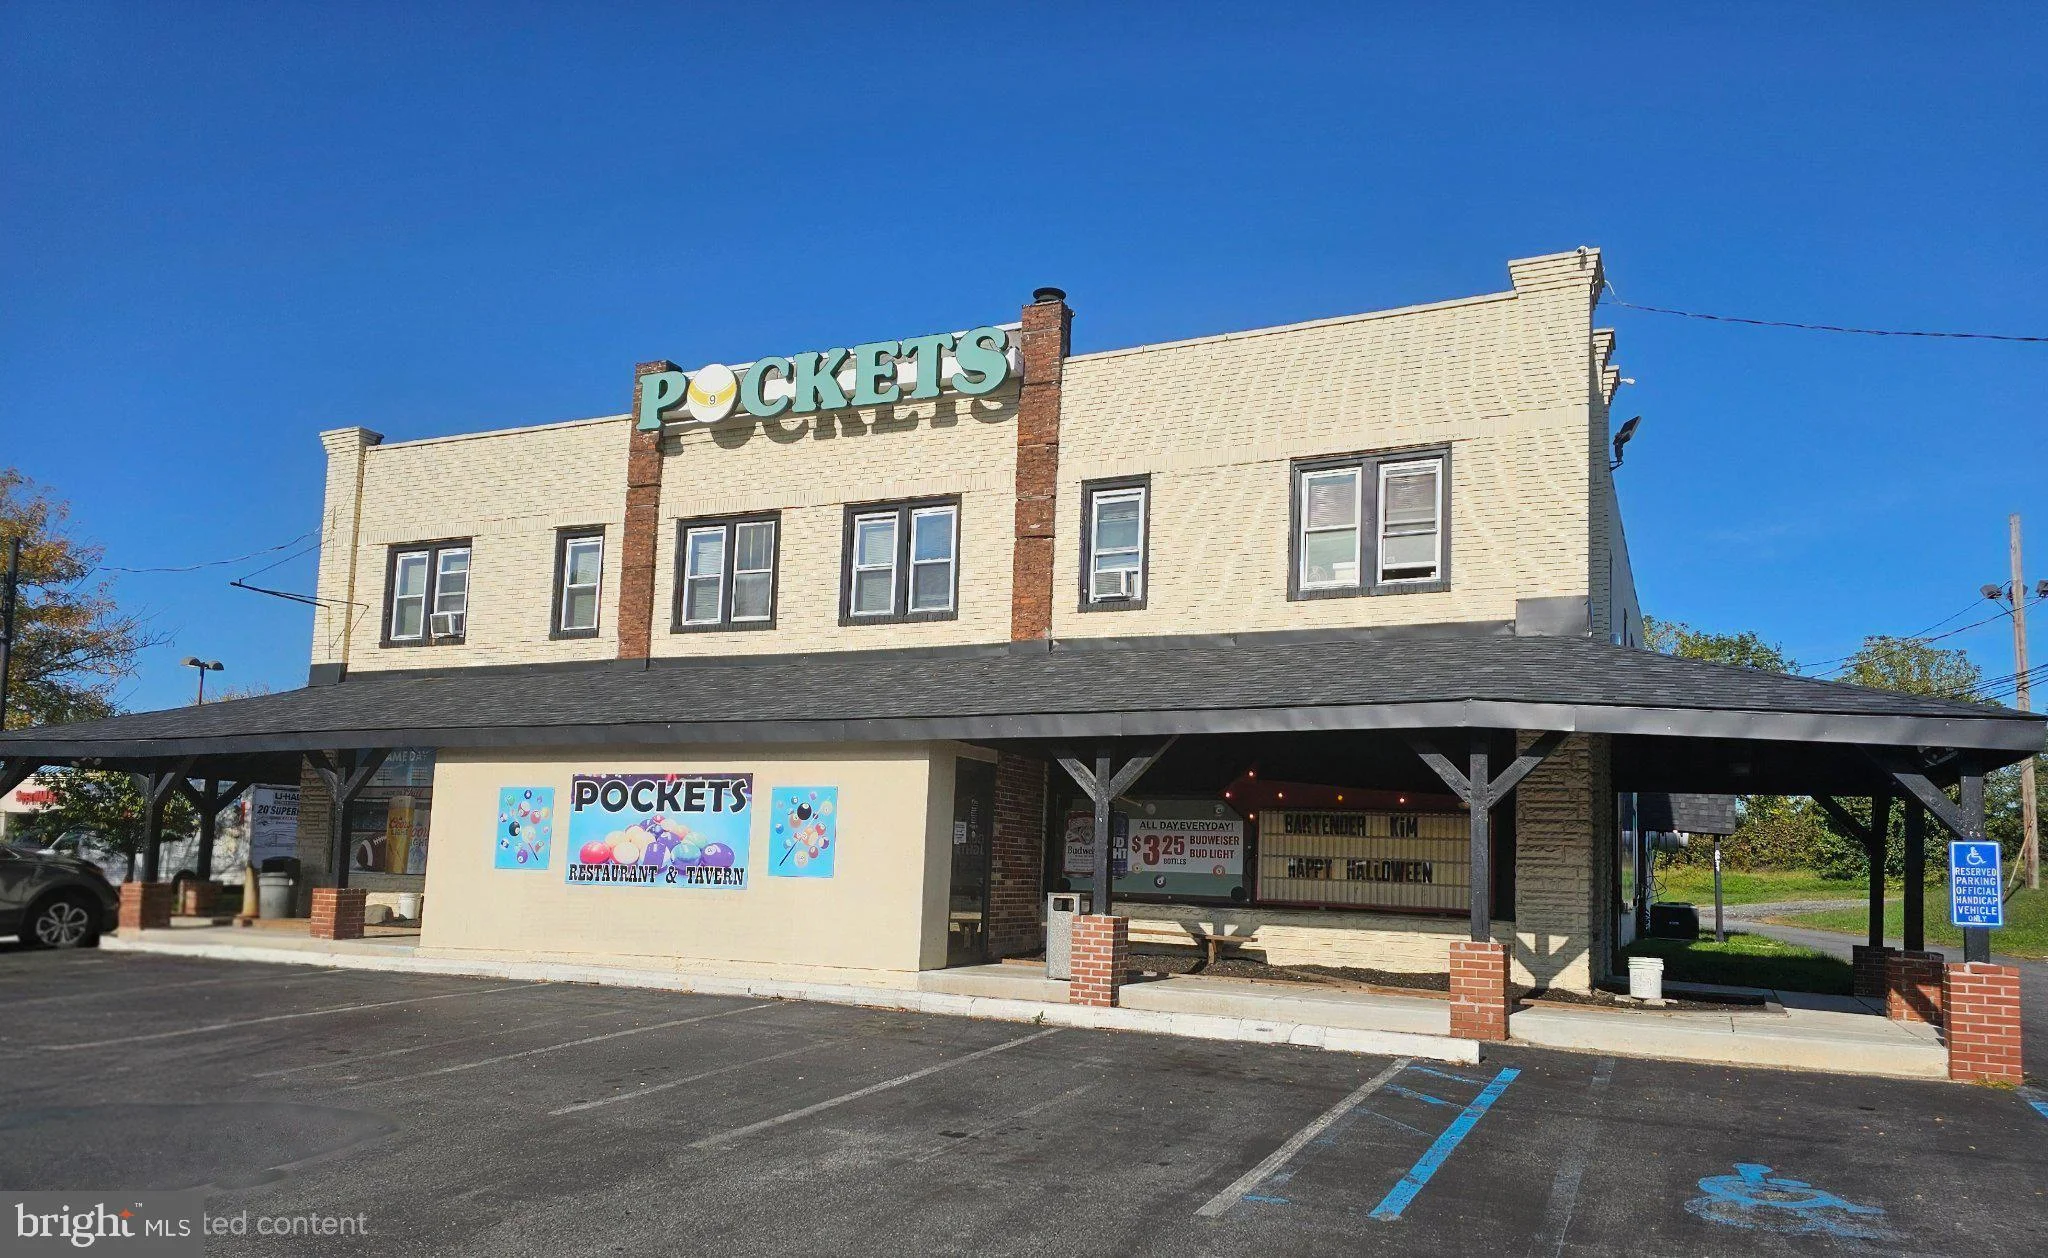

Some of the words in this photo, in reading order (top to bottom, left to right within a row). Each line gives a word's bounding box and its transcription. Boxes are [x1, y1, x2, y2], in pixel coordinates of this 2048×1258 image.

[573, 779, 748, 813] POCKETS
[270, 805, 299, 816] SUPER
[1140, 821, 1158, 830] ALL
[1285, 814, 1366, 837] BARTENDER
[1189, 836, 1240, 846] BUDWEISER
[1189, 849, 1208, 858] BUD
[1209, 849, 1235, 859] LIGHT
[568, 864, 658, 883] RESTAURANT
[665, 866, 679, 883] &
[686, 866, 745, 885] TAVERN
[1287, 857, 1333, 879] HAPPY
[1346, 859, 1433, 884] HALLOWEEN
[1955, 868, 1997, 876] RESERVED
[1956, 877, 1996, 885] PARKING
[1956, 887, 1997, 895] OFFICIAL
[1956, 896, 1998, 904] HANDICAP
[1958, 906, 1997, 915] VEHICLE
